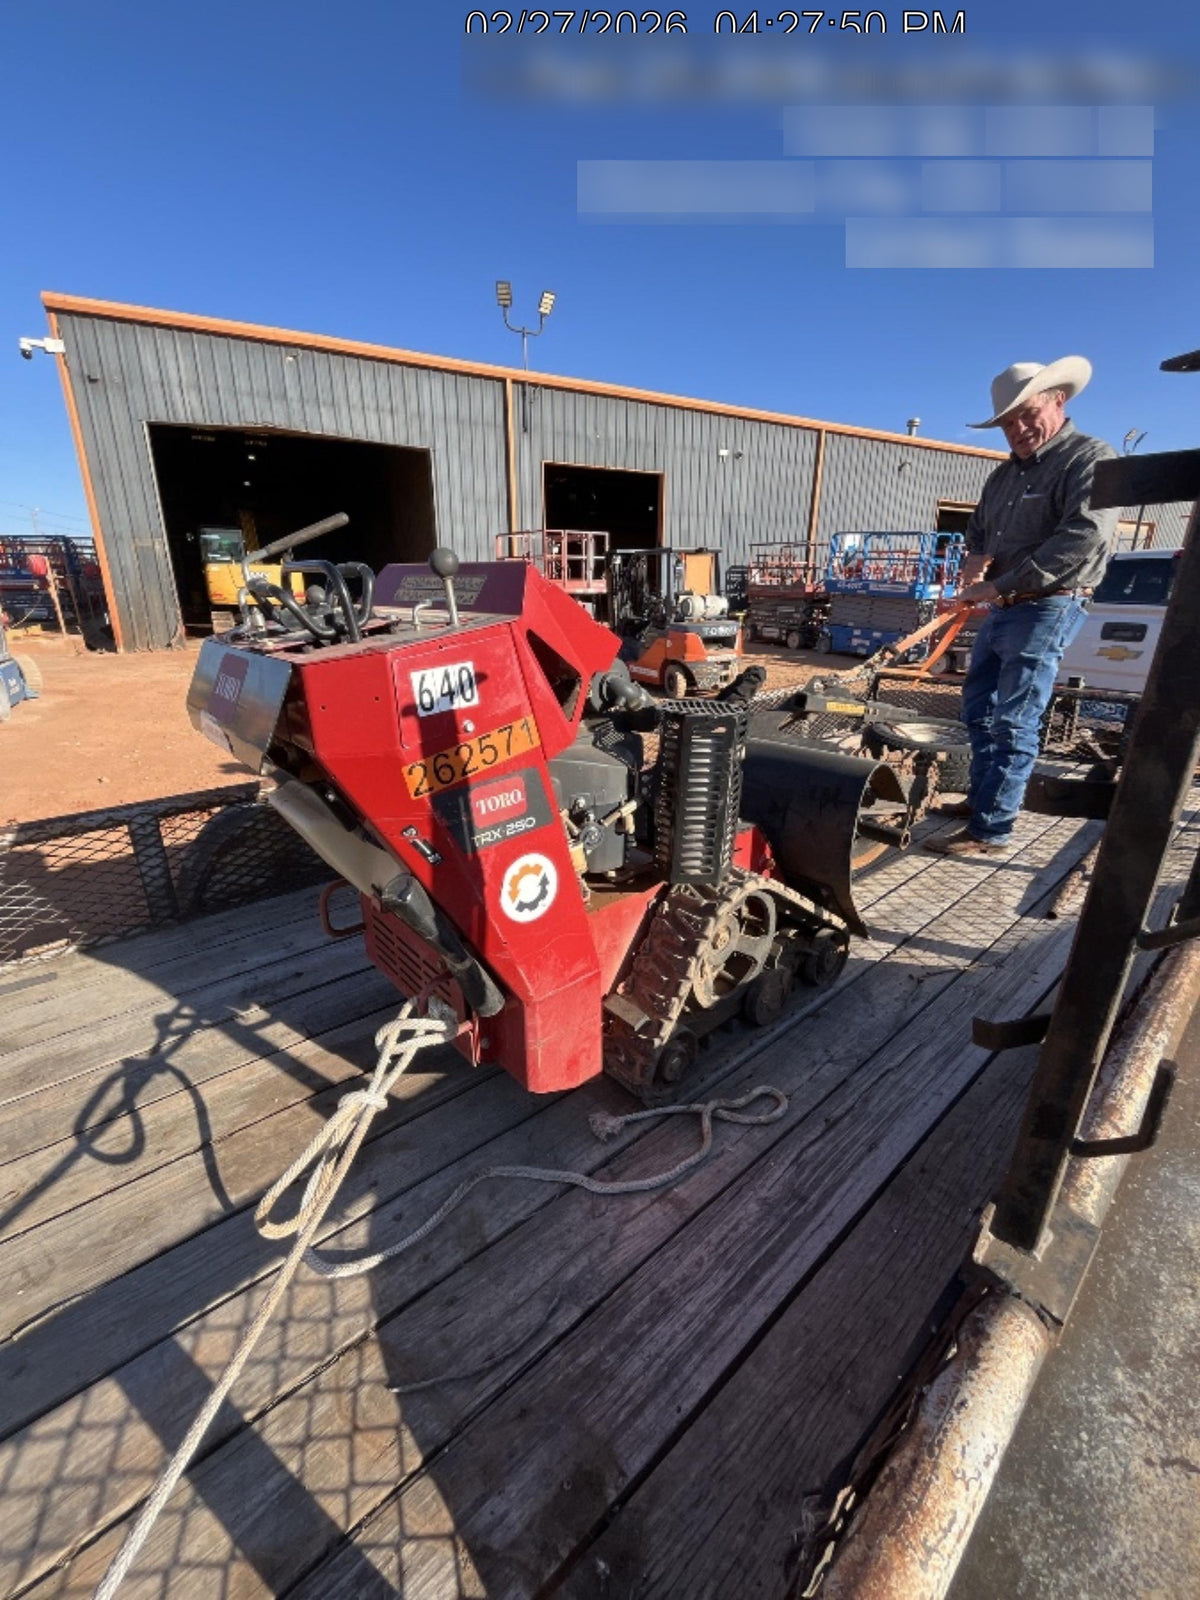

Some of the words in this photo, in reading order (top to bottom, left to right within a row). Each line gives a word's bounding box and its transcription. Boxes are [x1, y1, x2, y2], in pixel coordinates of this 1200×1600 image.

[418, 666, 475, 712] 640
[407, 718, 534, 797] 262571
[475, 788, 524, 815] TORO
